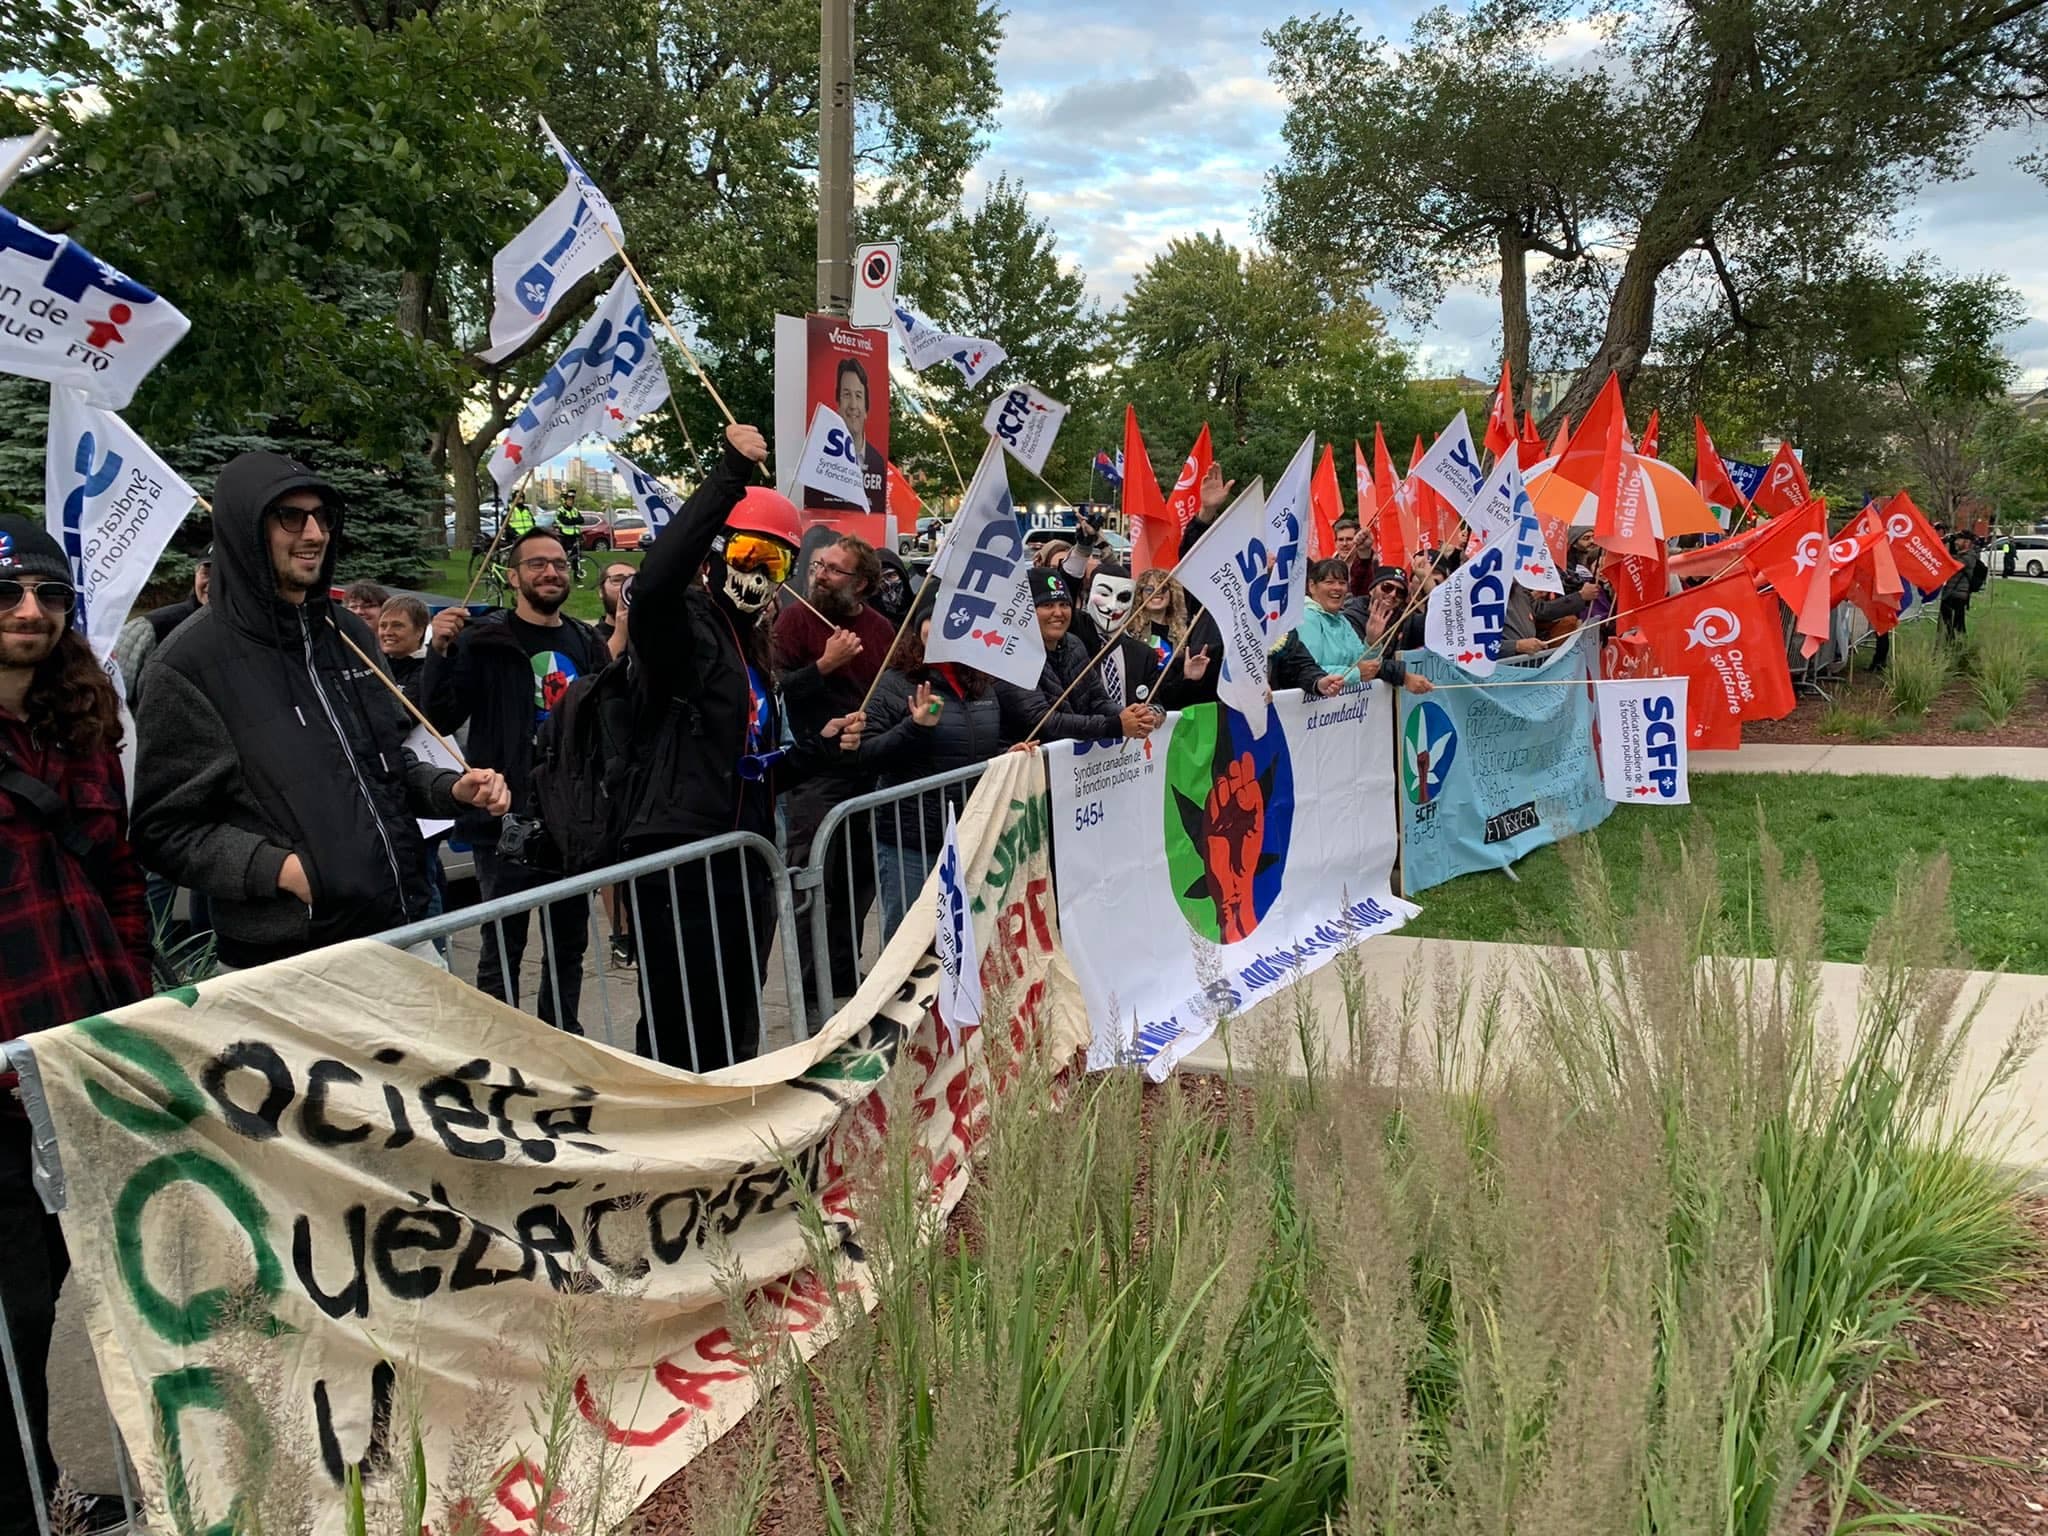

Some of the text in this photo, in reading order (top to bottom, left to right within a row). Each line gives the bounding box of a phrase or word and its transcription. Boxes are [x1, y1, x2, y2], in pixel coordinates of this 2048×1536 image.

[29, 297, 69, 326] de
[66, 343, 110, 373] FTQ
[997, 390, 1032, 447] SCFP
[815, 465, 825, 476] la
[818, 457, 848, 476] Syndicat
[1435, 465, 1469, 501] la fonction
[1441, 458, 1468, 487] Syndicat
[1486, 504, 1493, 515] la
[1904, 542, 1940, 578] solidaire
[1911, 534, 1943, 569] Québec
[1455, 595, 1465, 637] canadien
[1469, 547, 1505, 662] SCFP
[1209, 571, 1223, 586] la
[1233, 632, 1263, 686] publique
[1441, 609, 1455, 647] publique
[1710, 653, 1741, 715] solidaire
[1728, 649, 1755, 703] Québec
[1307, 697, 1370, 731] et combatif!
[1619, 699, 1627, 708] la
[1619, 708, 1632, 743] fonction
[1629, 699, 1645, 784] Syndicat canadien de
[1622, 742, 1633, 782] publique
[1643, 696, 1678, 798] SCFP
[1073, 750, 1142, 785] Syndicat canadien de
[1075, 783, 1082, 798] la
[1082, 775, 1112, 797] fonction
[1111, 766, 1141, 788] publique
[1075, 800, 1105, 832] 5454
[1415, 803, 1438, 824] SCFP
[1486, 819, 1501, 842] ET
